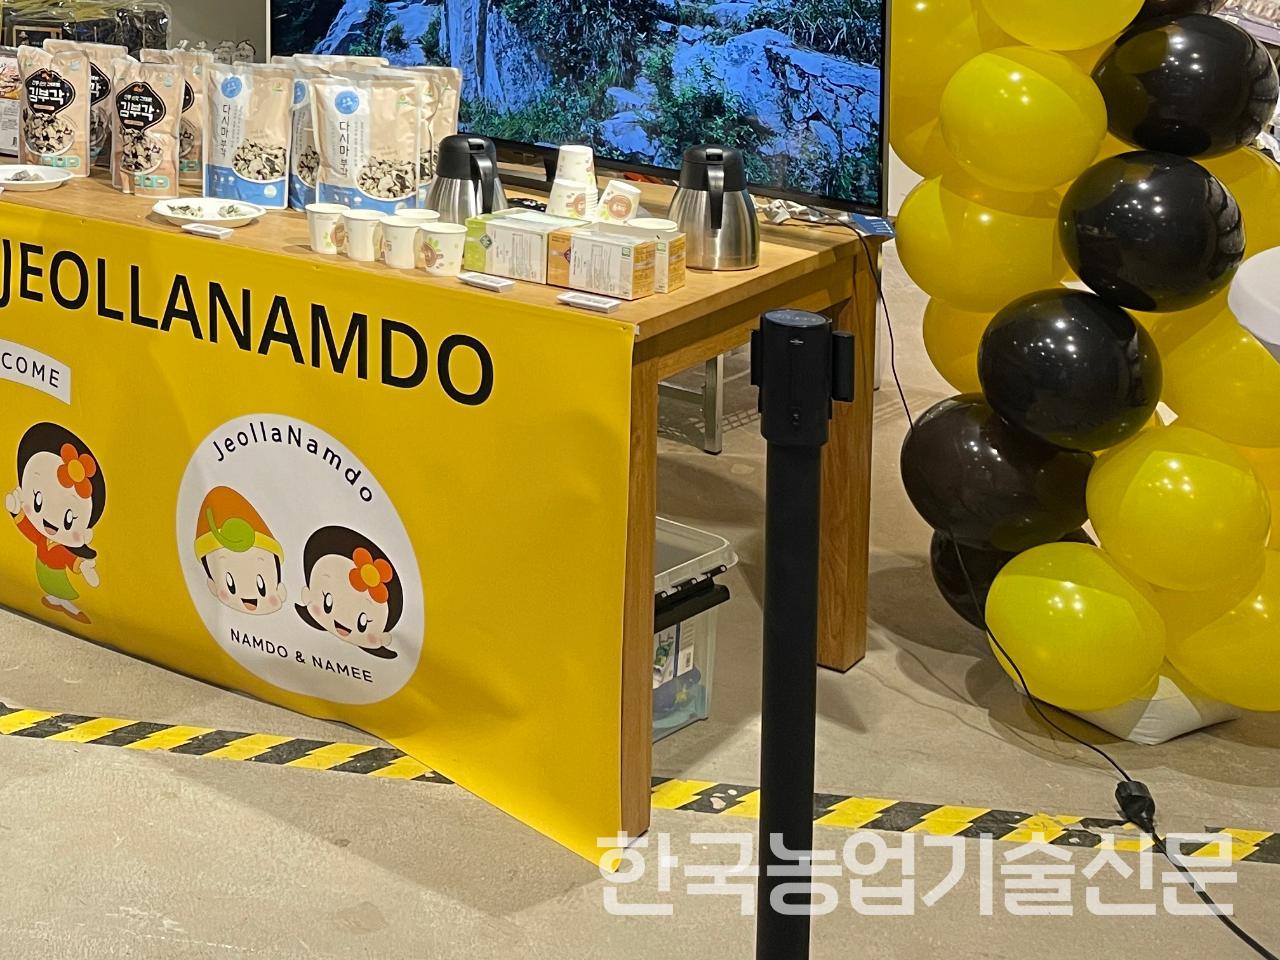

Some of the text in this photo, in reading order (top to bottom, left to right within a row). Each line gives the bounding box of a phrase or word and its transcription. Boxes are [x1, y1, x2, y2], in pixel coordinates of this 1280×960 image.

[28, 86, 65, 106] 김부각
[120, 101, 156, 122] 김부각
[212, 419, 374, 505] JeollaNamdo
[230, 627, 374, 685] NAMDO & NAMEE
